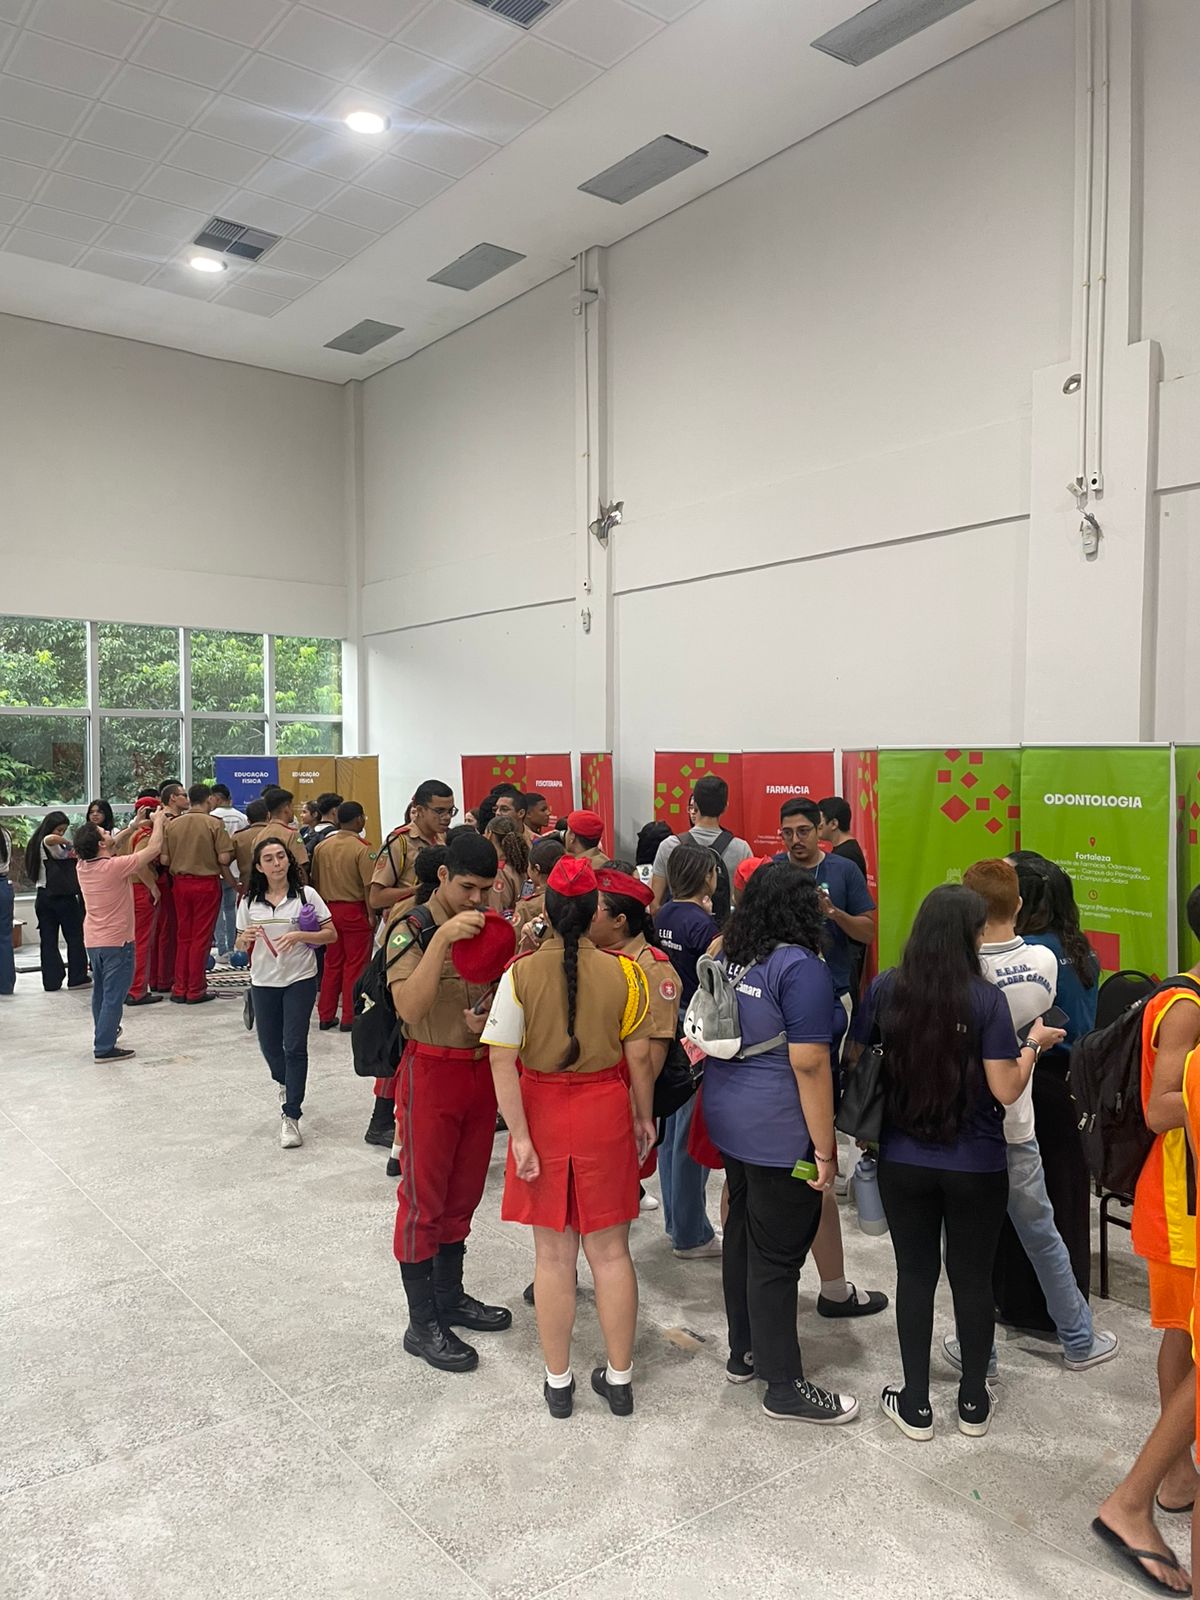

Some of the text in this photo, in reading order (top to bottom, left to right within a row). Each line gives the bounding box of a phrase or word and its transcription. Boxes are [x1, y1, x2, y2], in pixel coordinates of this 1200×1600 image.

[766, 784, 810, 794] FARMÁCIA
[1043, 793, 1143, 808] ODONTOLOGIA
[1075, 852, 1111, 862] Fortaleza
[997, 974, 1025, 989] ELDER
